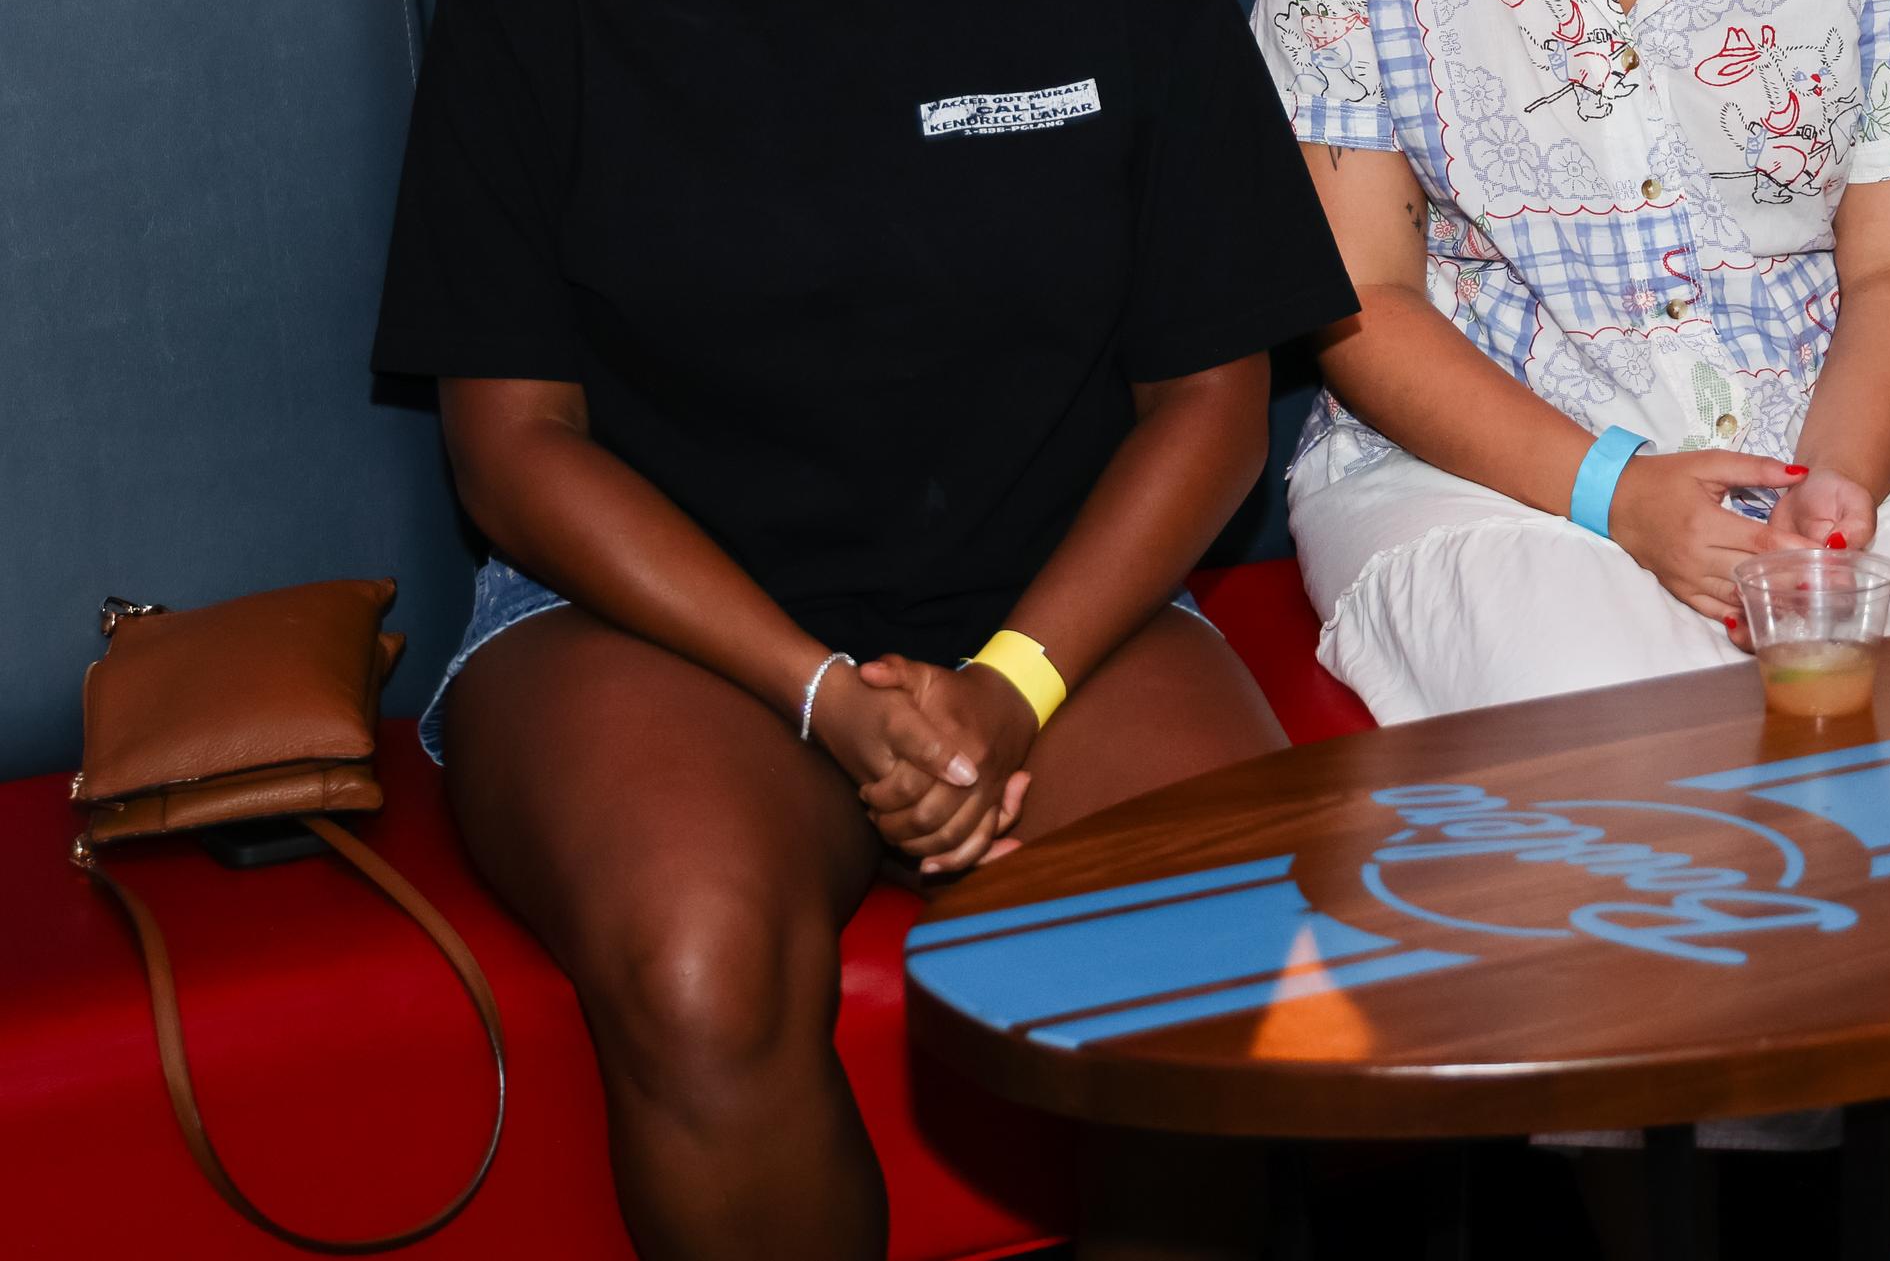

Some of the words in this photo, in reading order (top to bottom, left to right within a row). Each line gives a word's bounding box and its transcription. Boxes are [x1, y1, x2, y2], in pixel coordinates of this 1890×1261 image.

[992, 95, 1024, 105] OUT
[1029, 83, 1090, 101] MURAL?
[929, 113, 1025, 133] KENDRICK
[1031, 102, 1094, 122] LAMAR
[975, 102, 1045, 116] CALL
[1370, 782, 1860, 965] Bowlero
